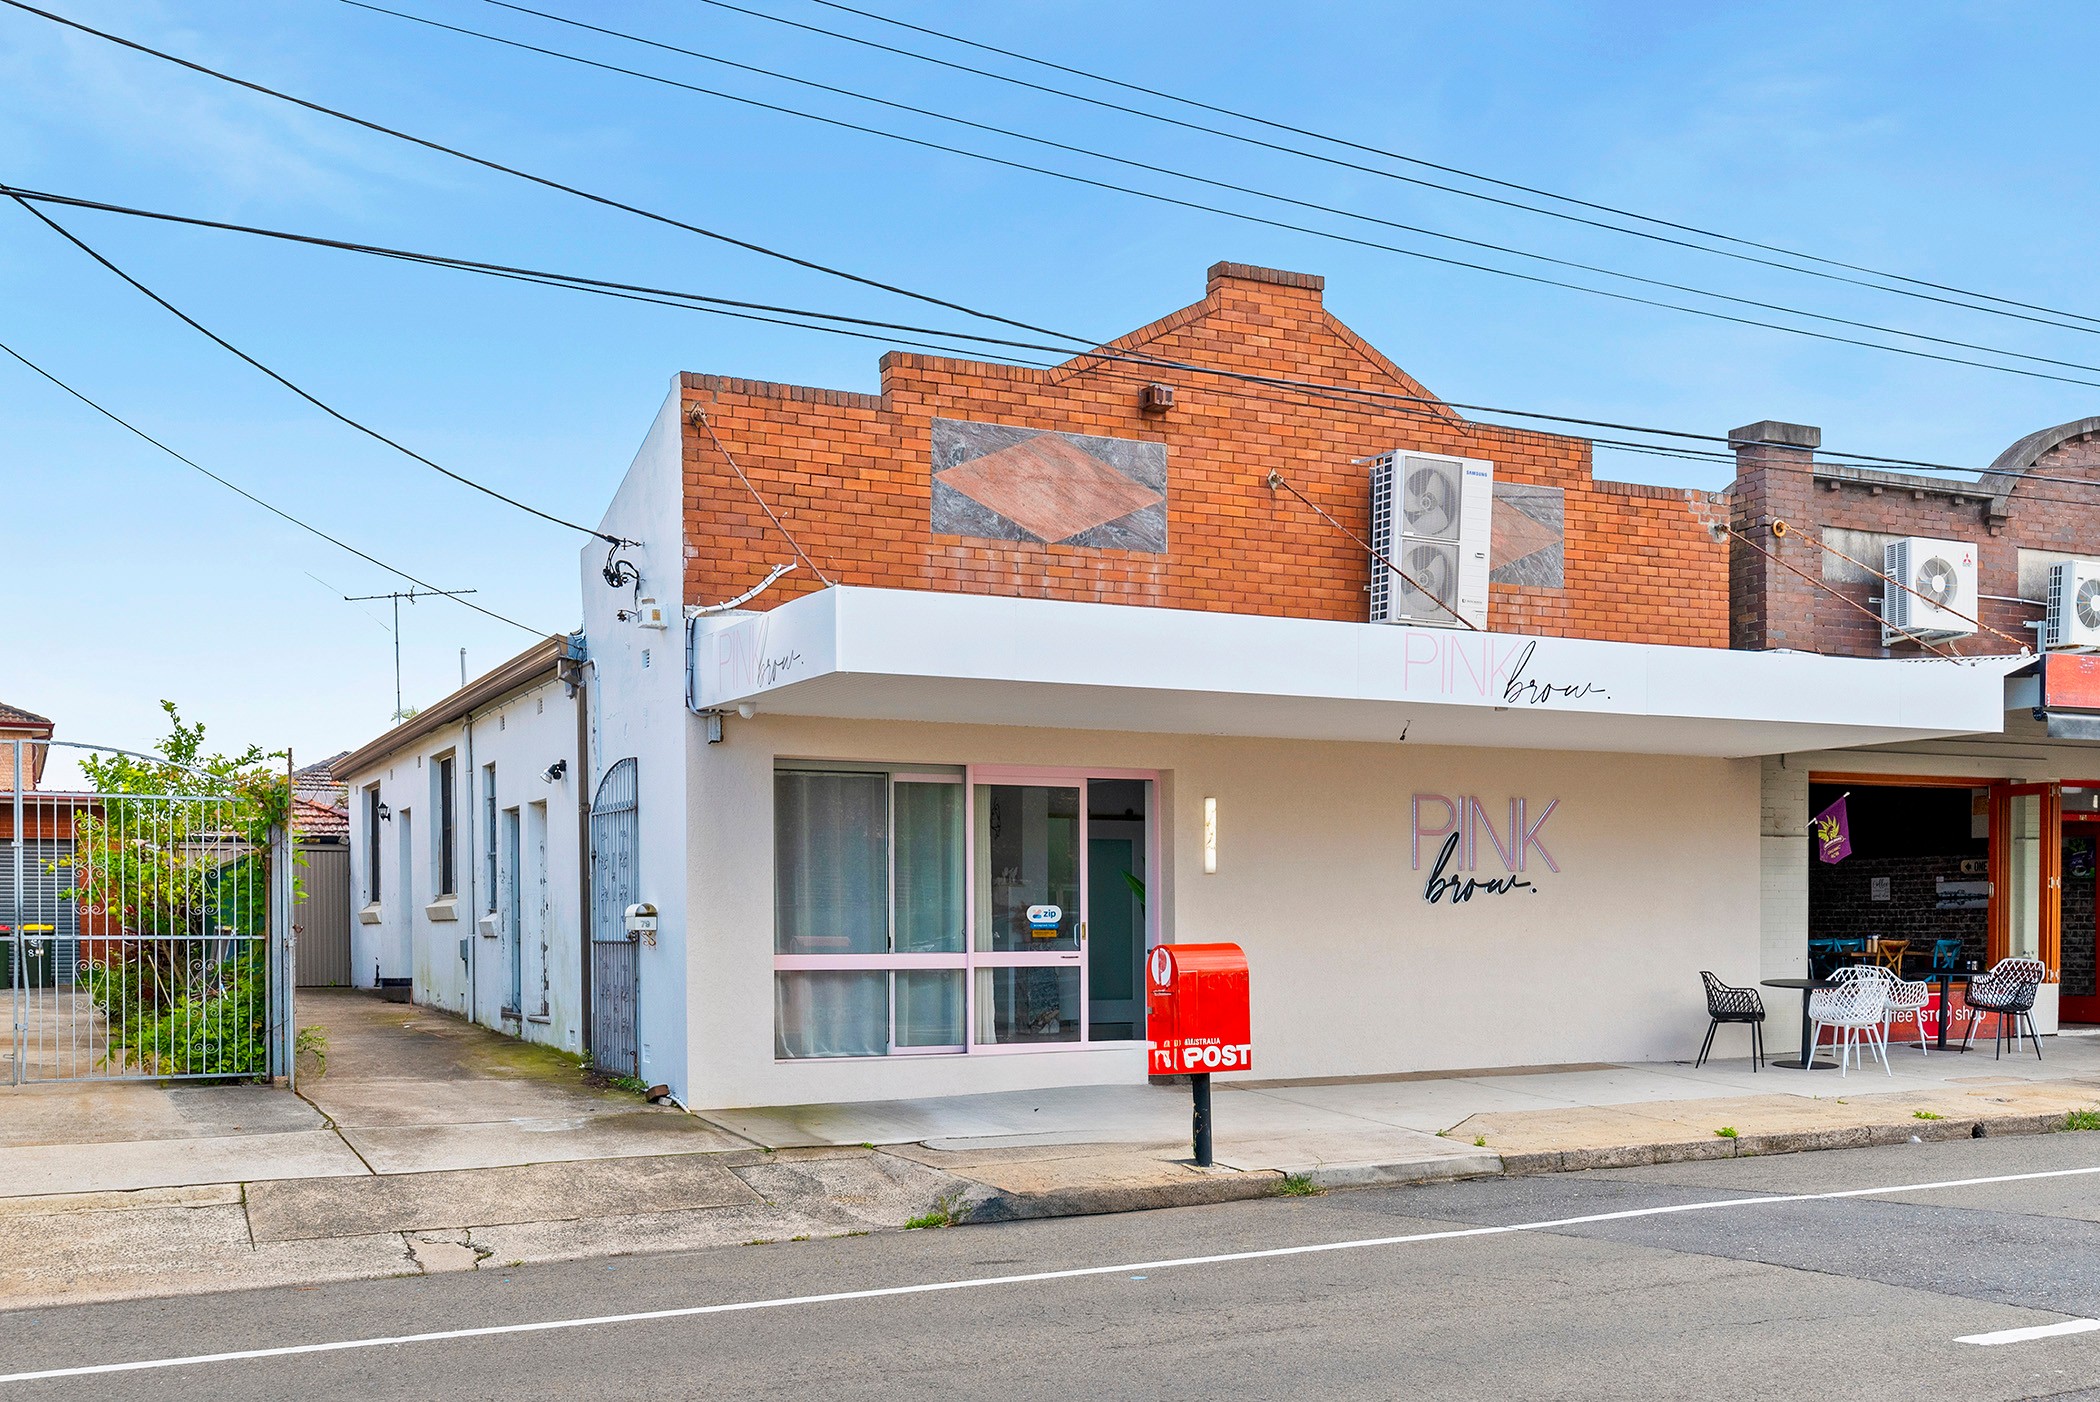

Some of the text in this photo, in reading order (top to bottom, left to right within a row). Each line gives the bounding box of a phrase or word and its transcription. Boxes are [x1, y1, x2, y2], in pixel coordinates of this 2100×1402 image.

[1466, 470, 1488, 478] SAMSUNG
[719, 620, 765, 693] PINK
[1404, 631, 1522, 697] PINK
[1411, 793, 1562, 873] PINK
[1974, 861, 1988, 872] ONE
[1043, 909, 1057, 919] zip
[1183, 1043, 1252, 1069] POST
